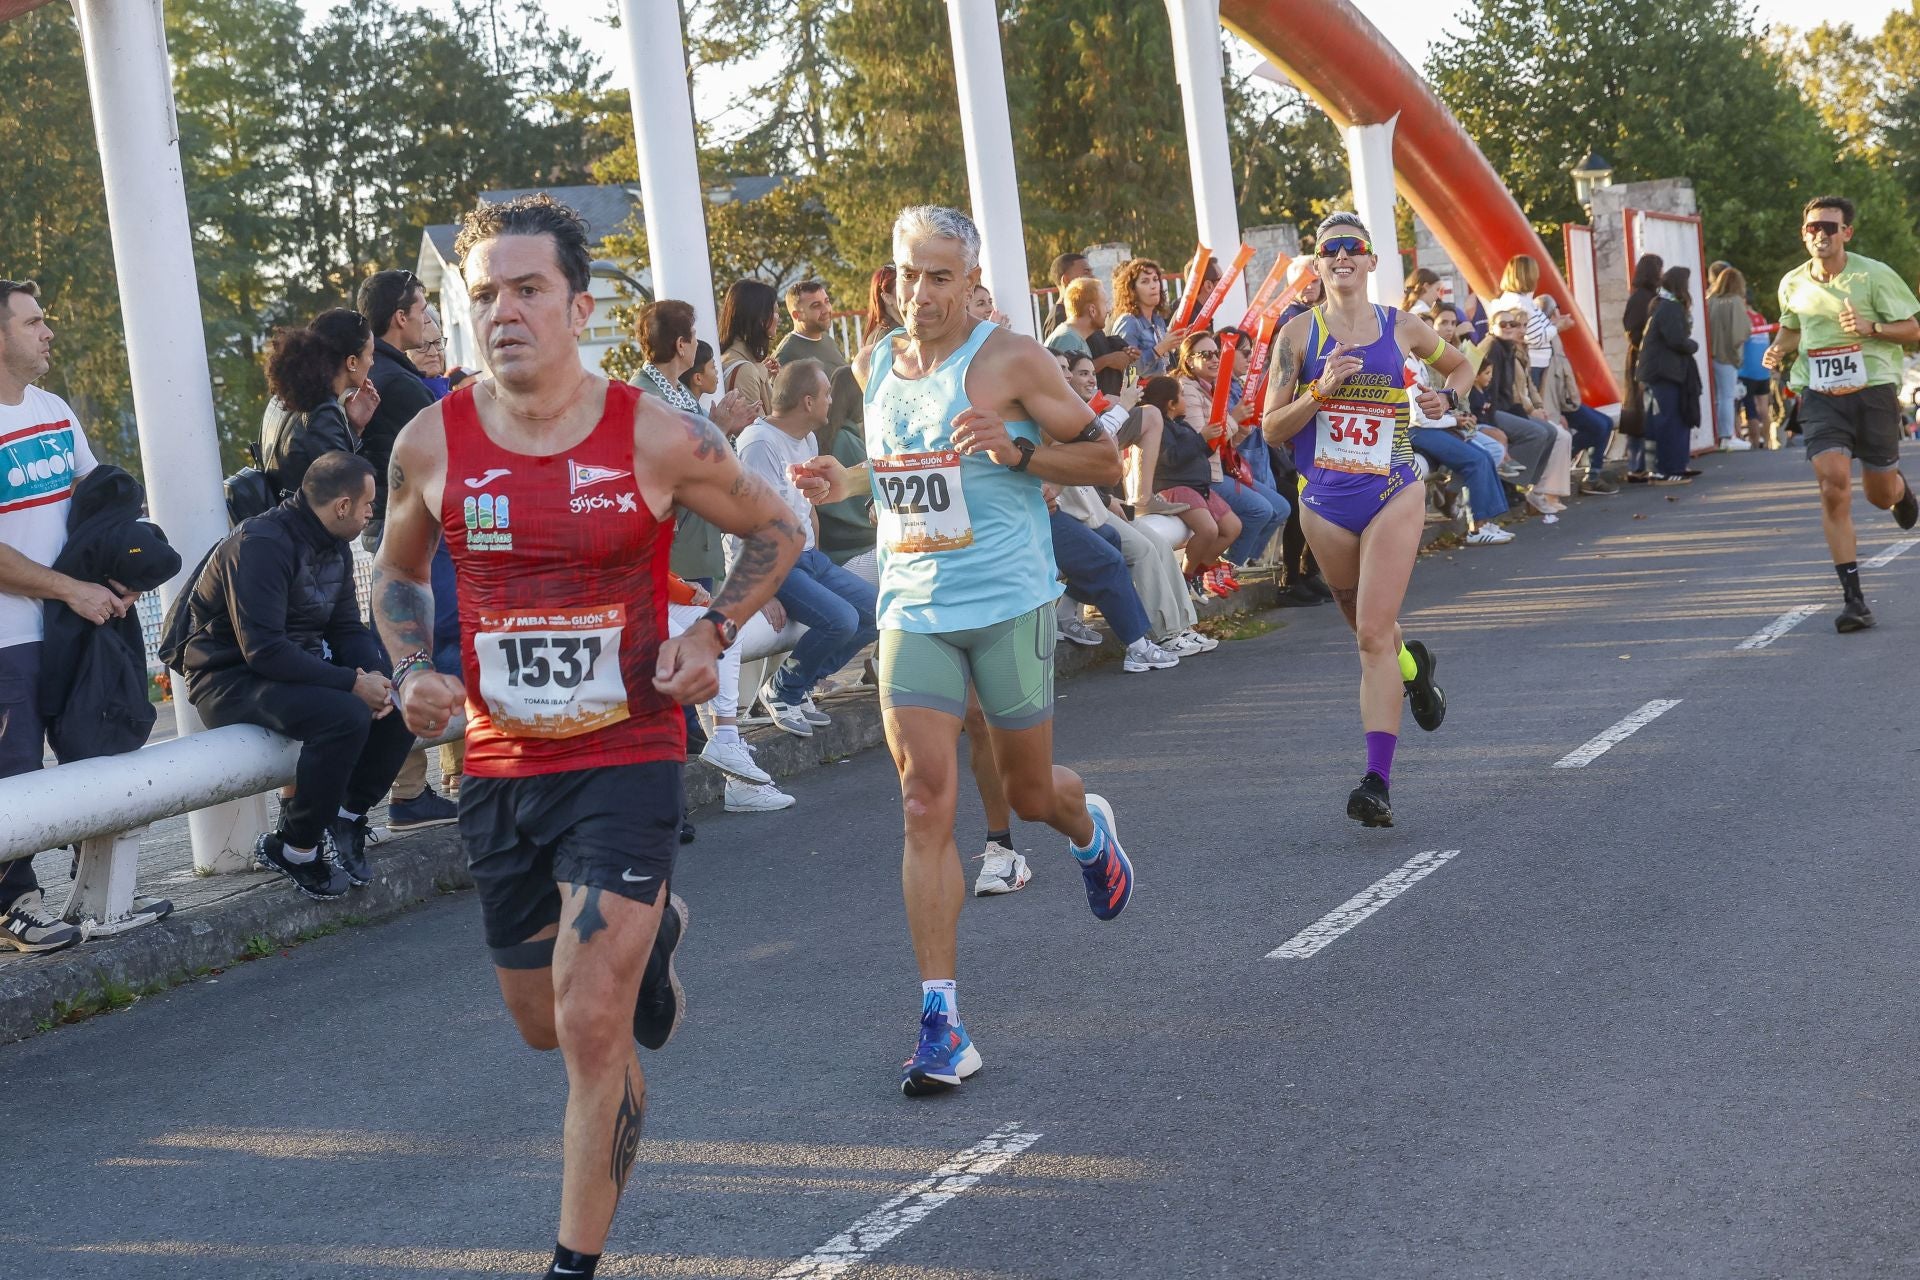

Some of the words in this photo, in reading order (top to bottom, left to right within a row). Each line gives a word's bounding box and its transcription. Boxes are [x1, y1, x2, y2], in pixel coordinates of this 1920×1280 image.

[1816, 356, 1857, 378] 1794
[1349, 374, 1393, 386] SITGES
[1328, 415, 1382, 447] 343
[570, 493, 616, 514] gijón
[879, 473, 951, 515] 1220
[466, 530, 513, 544] Asturias
[516, 616, 548, 627] MBA
[572, 613, 603, 626] GIJÓN
[498, 636, 602, 689] 1531
